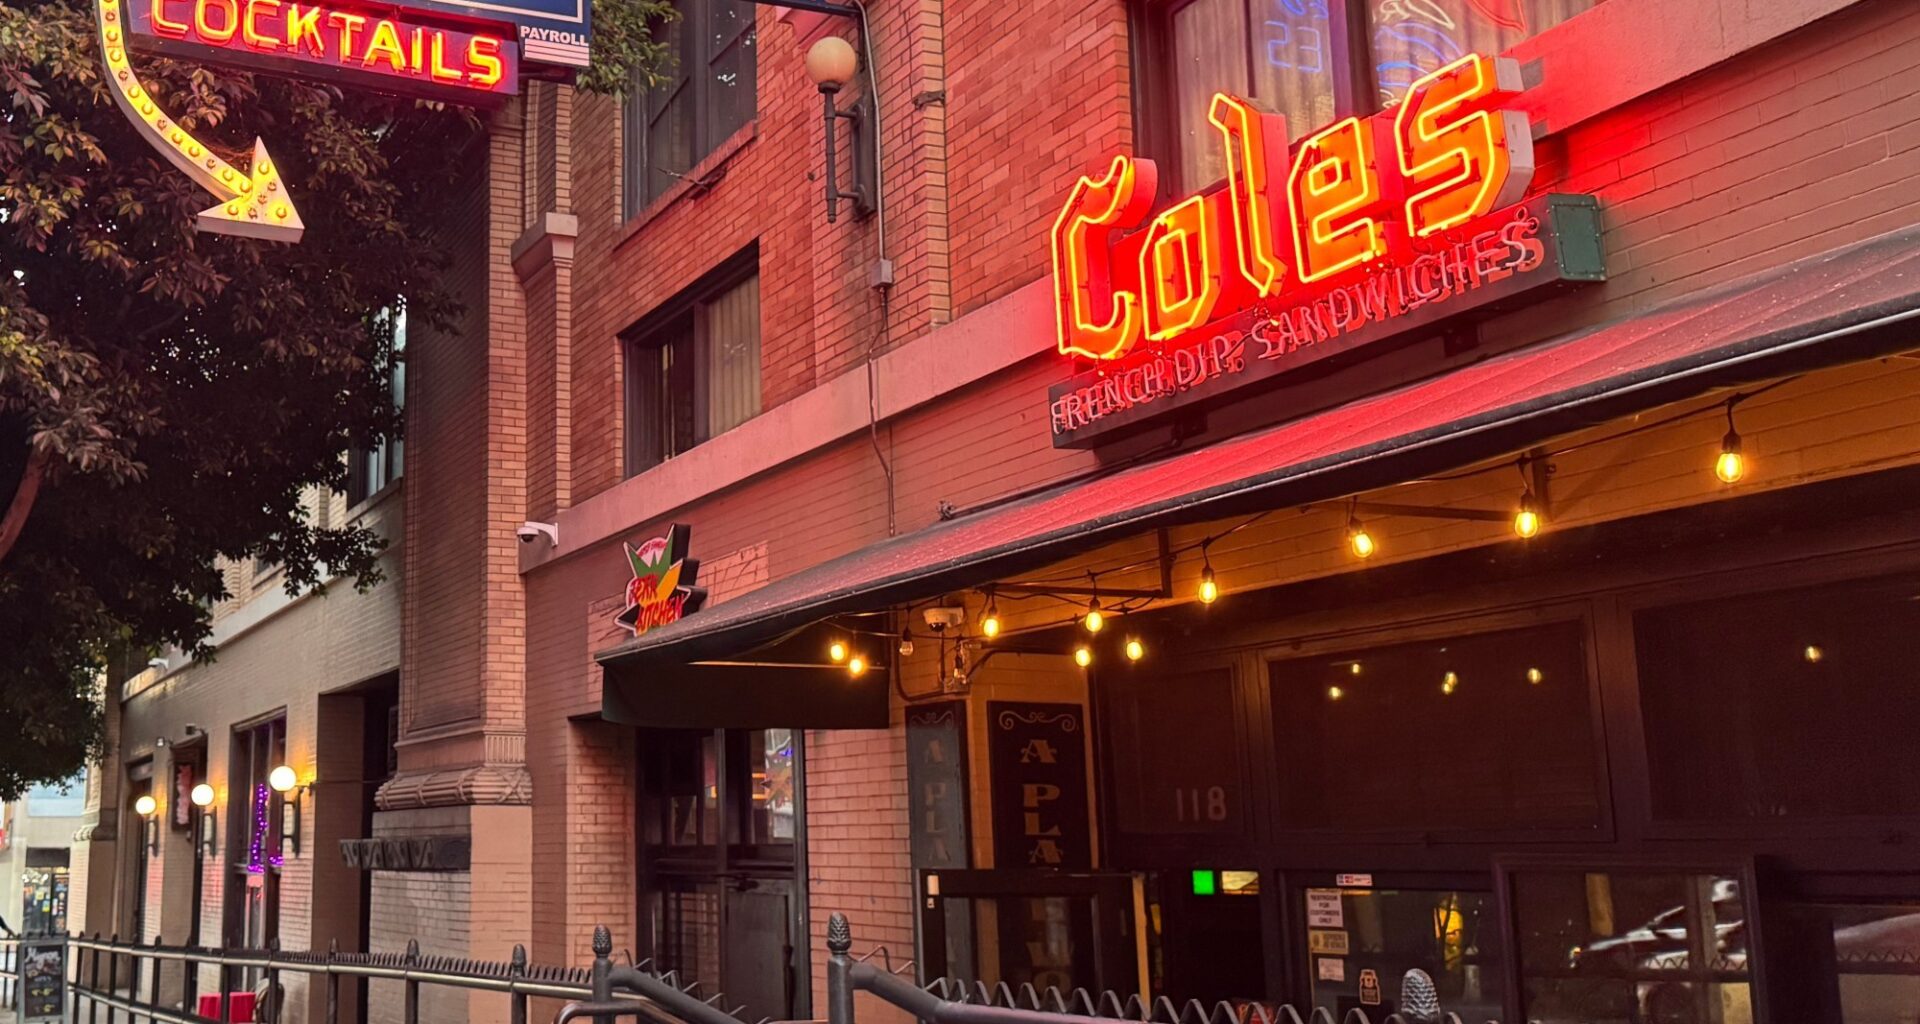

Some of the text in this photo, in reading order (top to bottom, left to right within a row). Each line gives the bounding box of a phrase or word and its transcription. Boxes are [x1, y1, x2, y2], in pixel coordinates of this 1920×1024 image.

[151, 0, 503, 91] COCKTAILS
[520, 25, 590, 47] PAYROLL
[1051, 52, 1514, 360] Coles
[1050, 362, 1174, 435] FRENCH
[1251, 210, 1545, 361] SANDWICHES
[1020, 739, 1058, 764] A
[1175, 786, 1227, 822] 118
